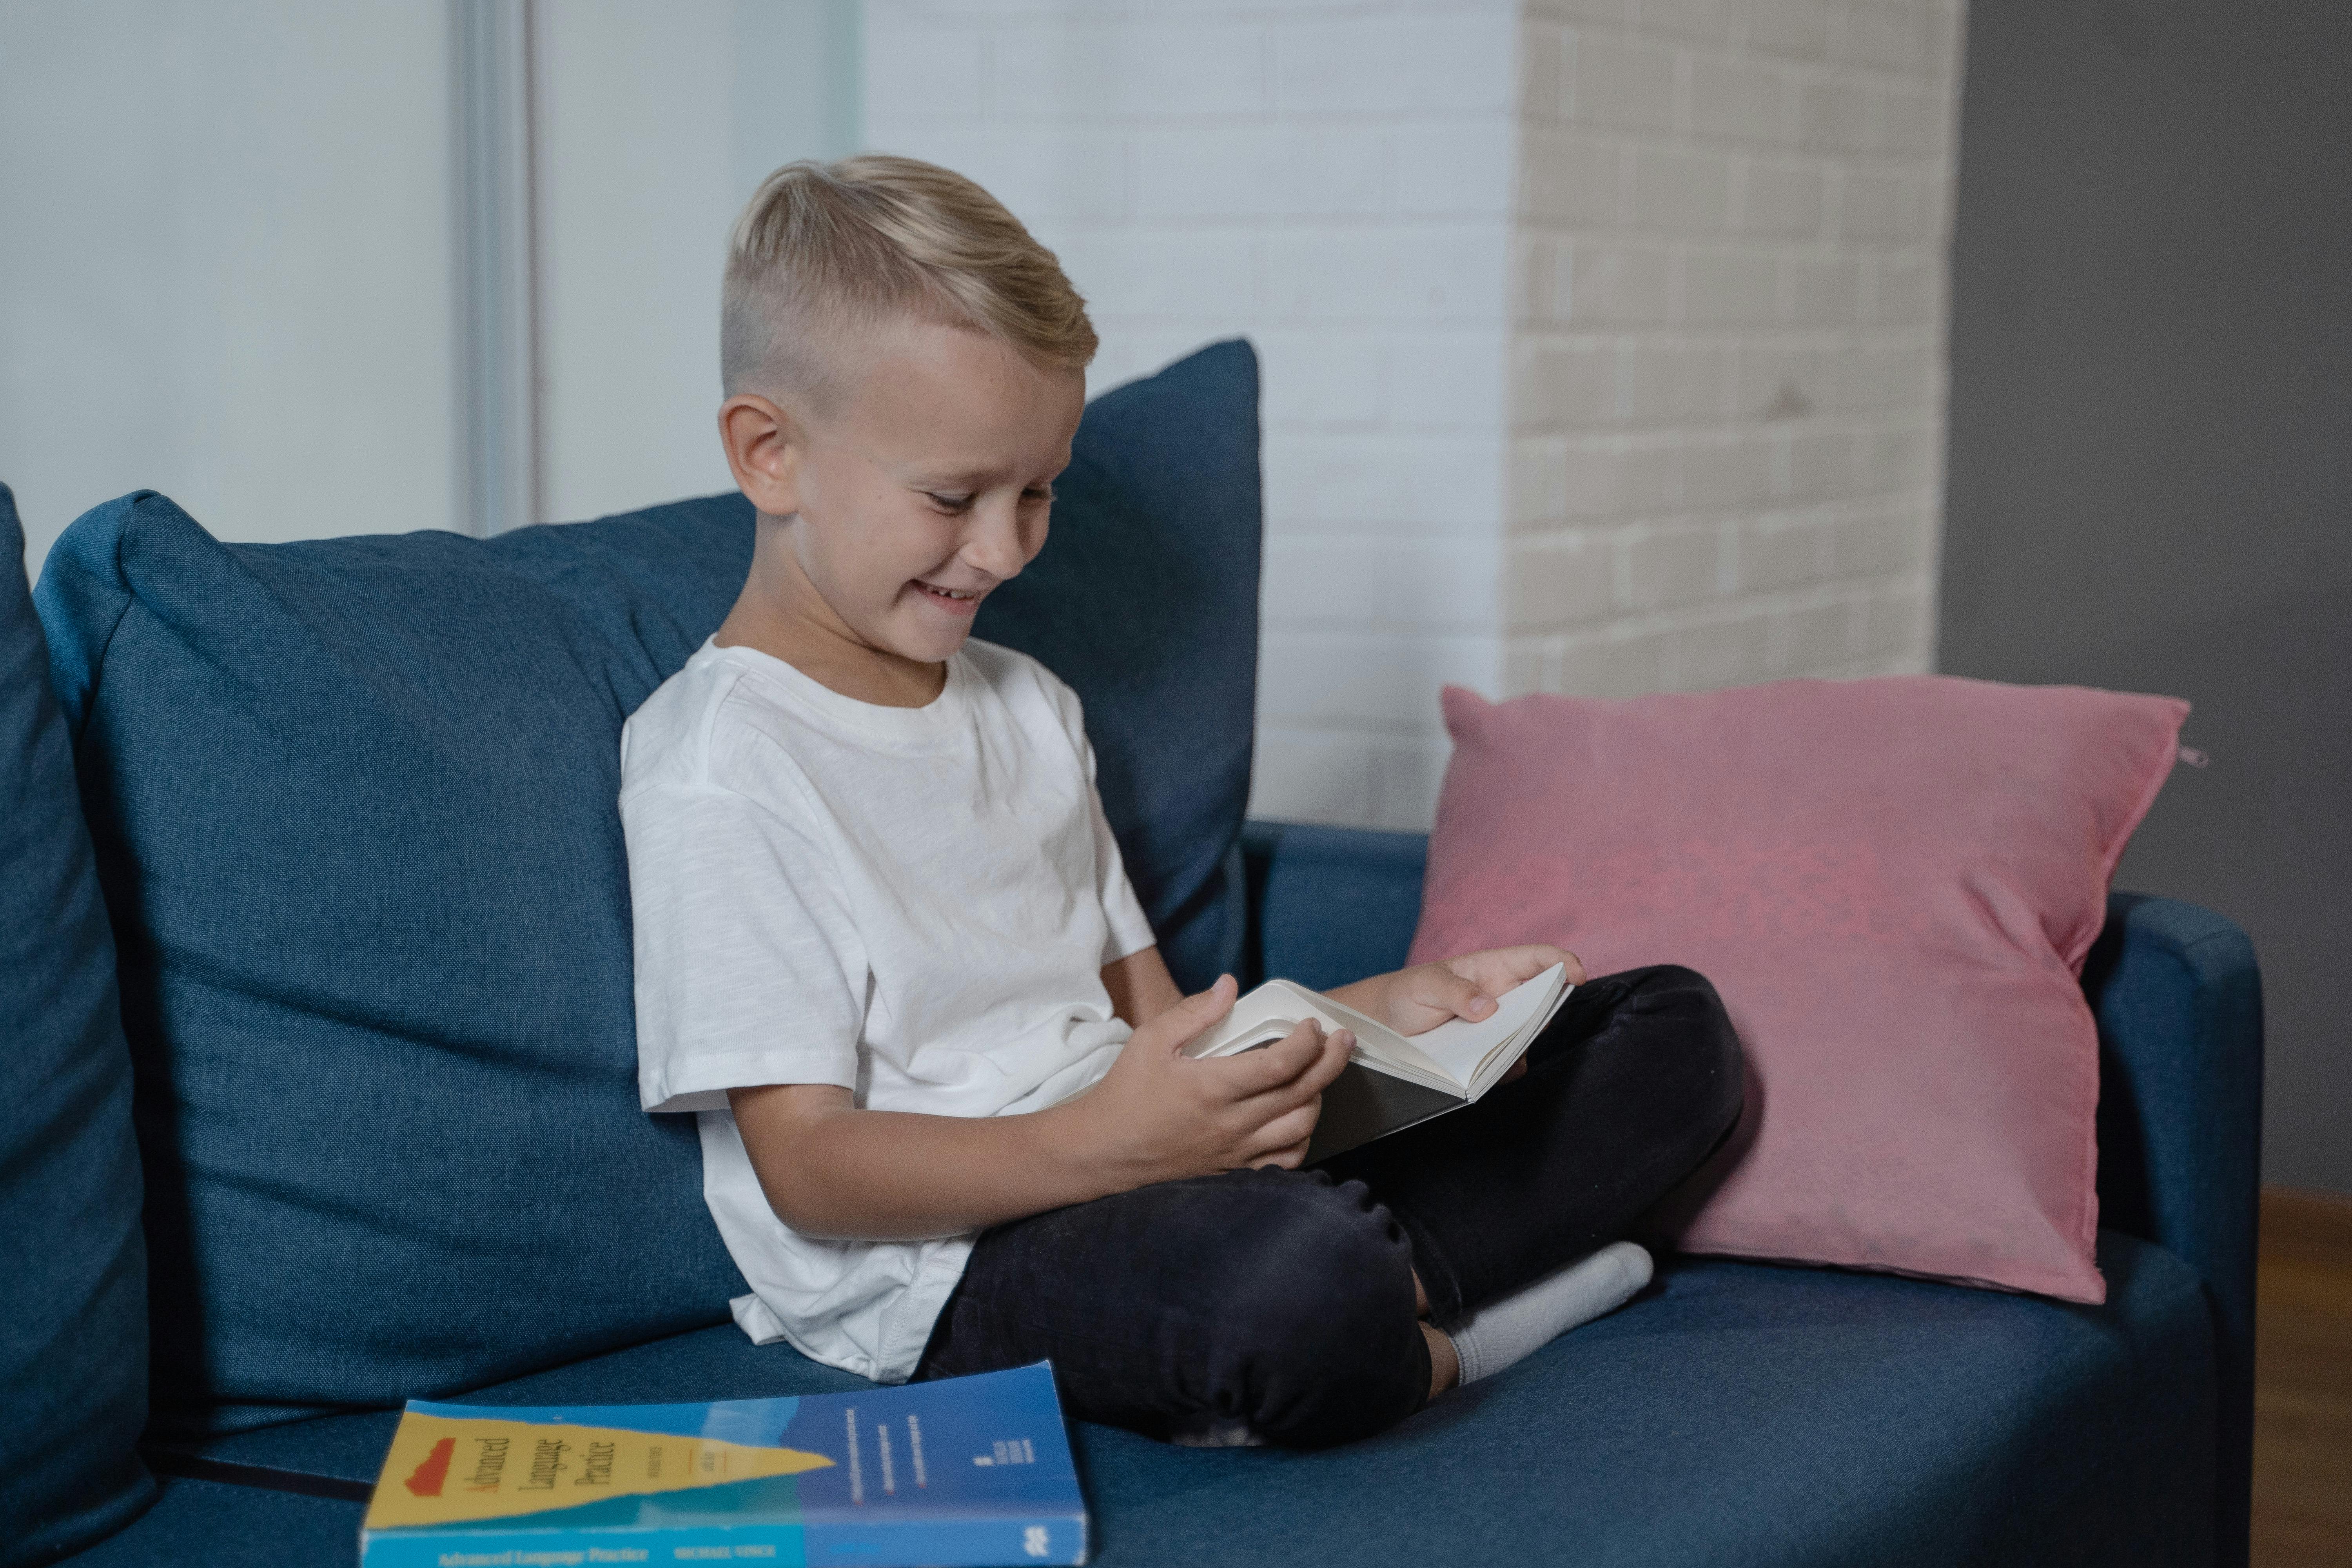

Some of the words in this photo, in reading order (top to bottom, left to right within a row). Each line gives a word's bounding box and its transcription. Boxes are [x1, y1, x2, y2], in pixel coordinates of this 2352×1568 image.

[464, 1438, 510, 1494] Advanced
[518, 1439, 571, 1490] Language
[574, 1442, 615, 1485] Practice
[439, 1551, 514, 1567] Advanced
[515, 1550, 584, 1567] Language
[589, 1548, 648, 1563] Practice
